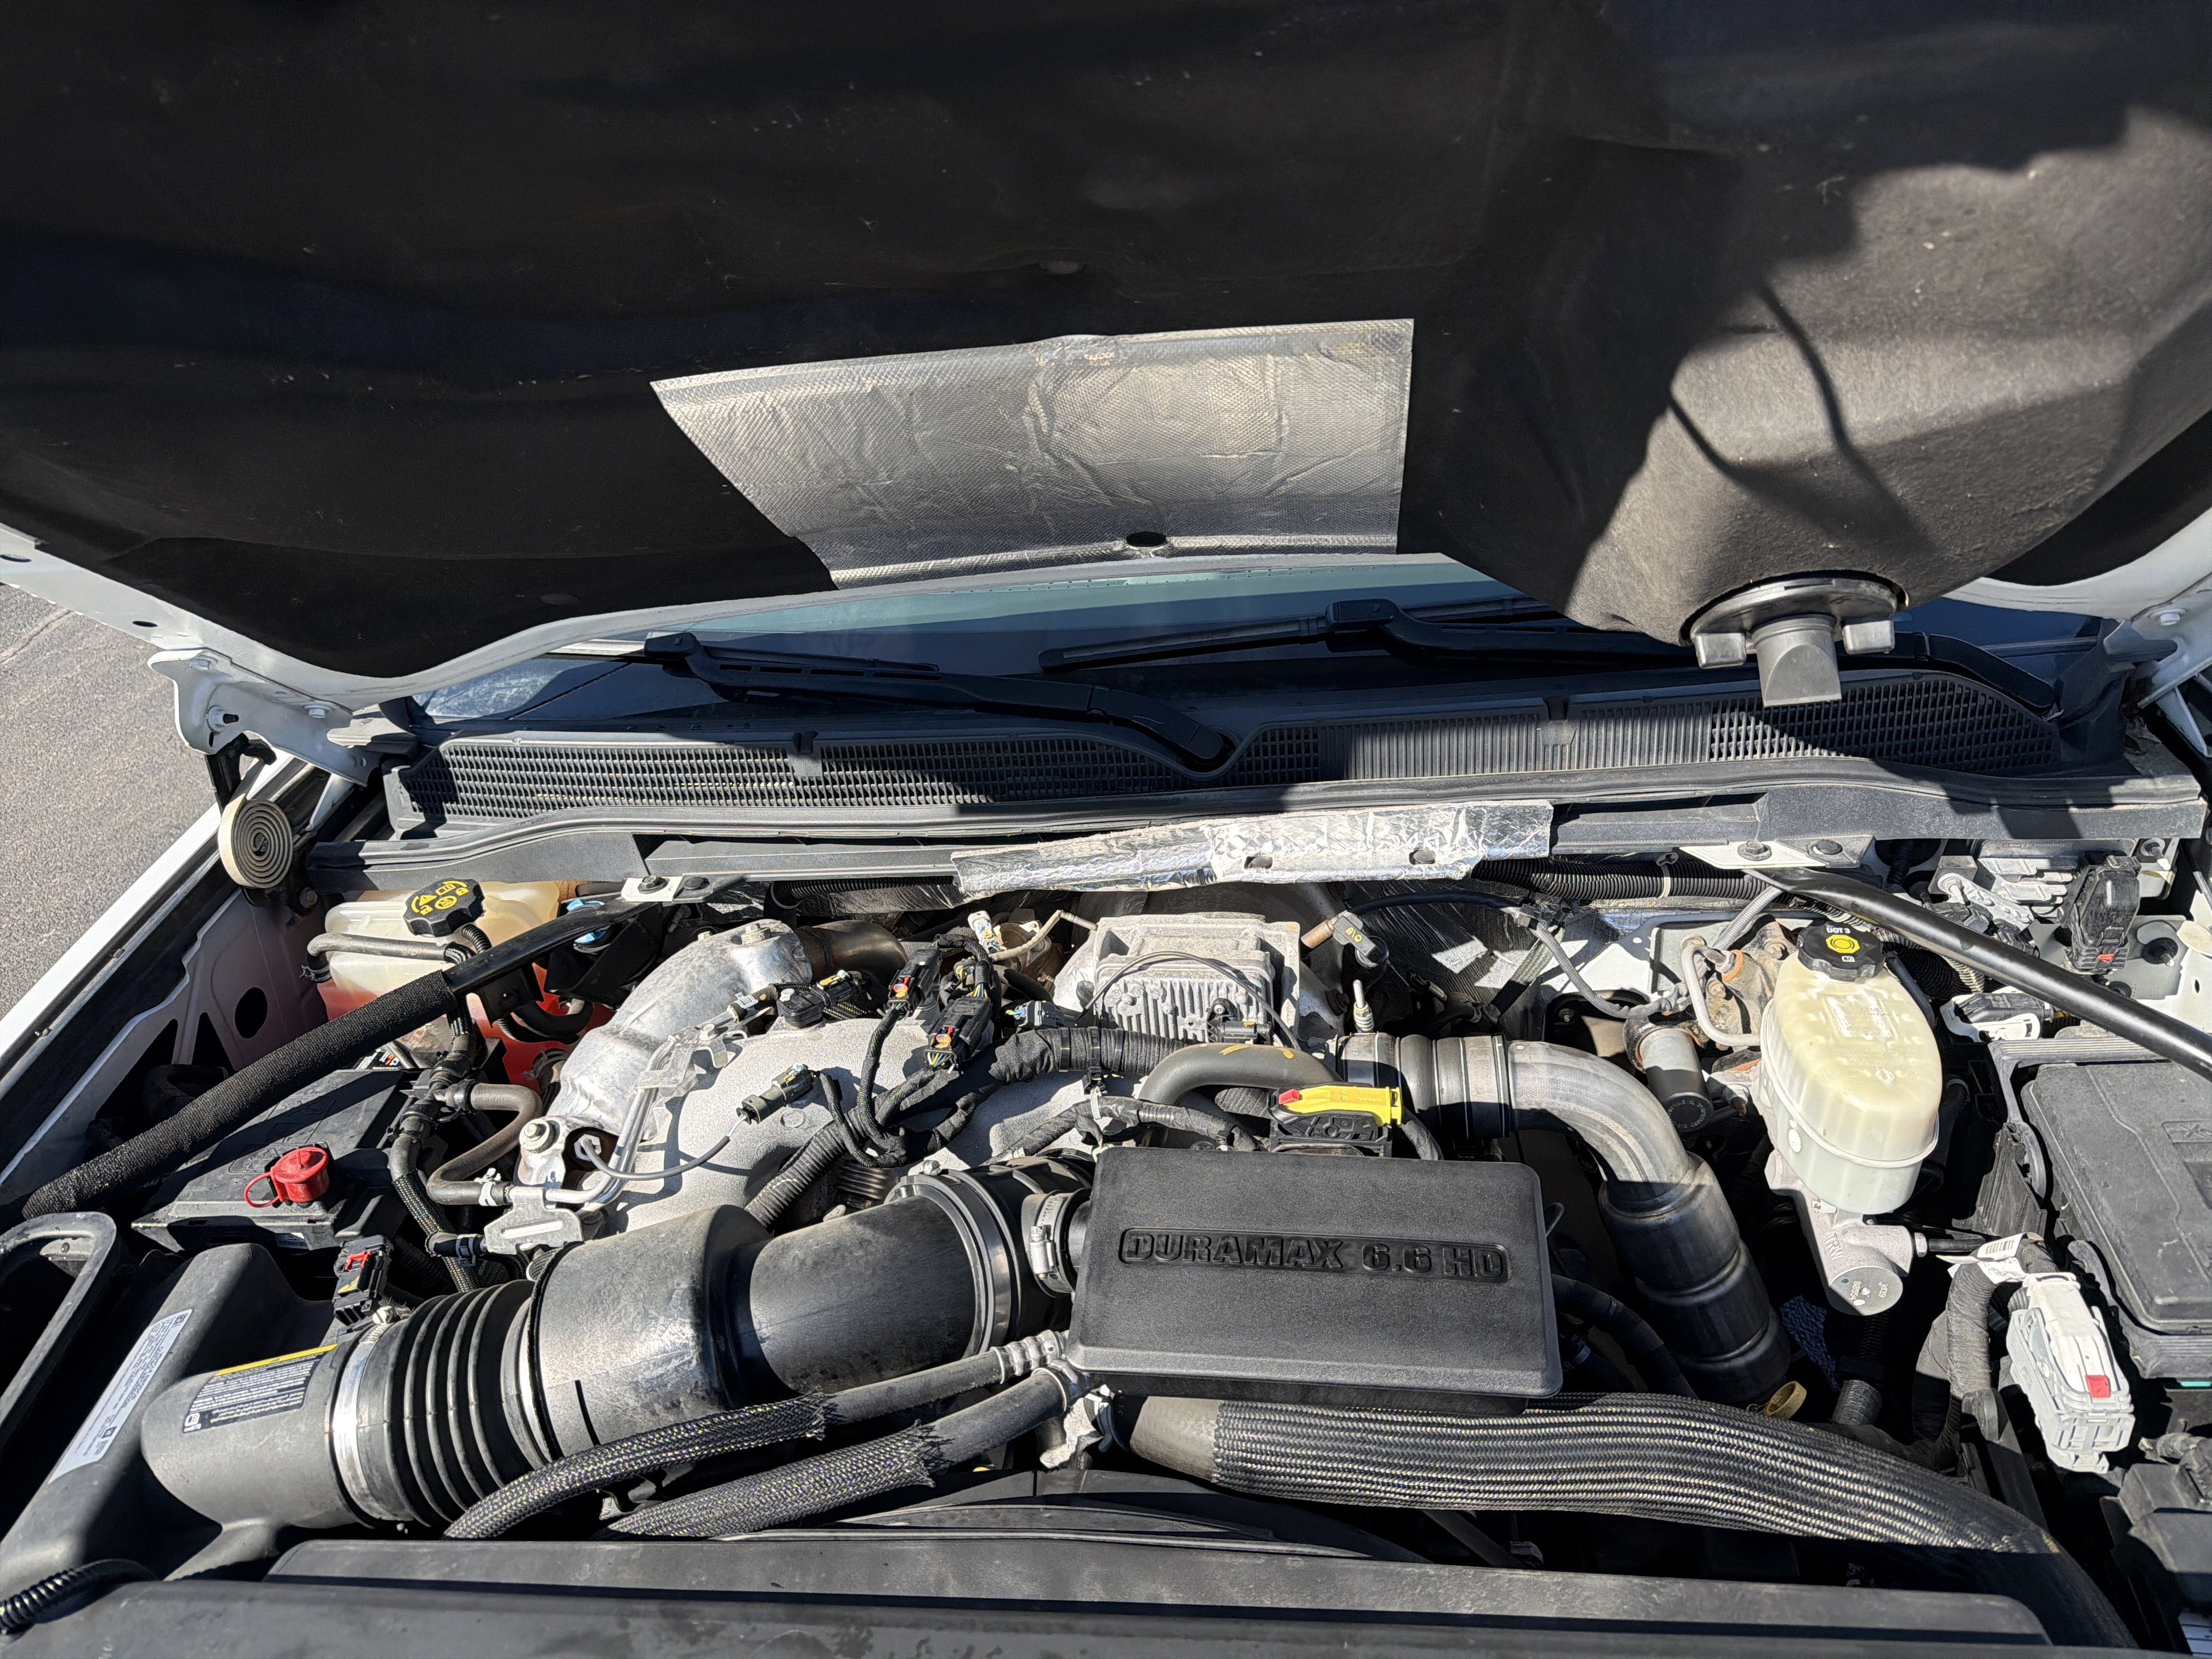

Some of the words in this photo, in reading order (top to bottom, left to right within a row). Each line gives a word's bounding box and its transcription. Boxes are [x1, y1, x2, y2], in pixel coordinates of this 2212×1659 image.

[1125, 1234, 1344, 1268] DURAMAX
[1361, 1243, 1432, 1273] 6.6
[1442, 1247, 1504, 1278] HD
[1825, 1233, 1844, 1260] TRW
